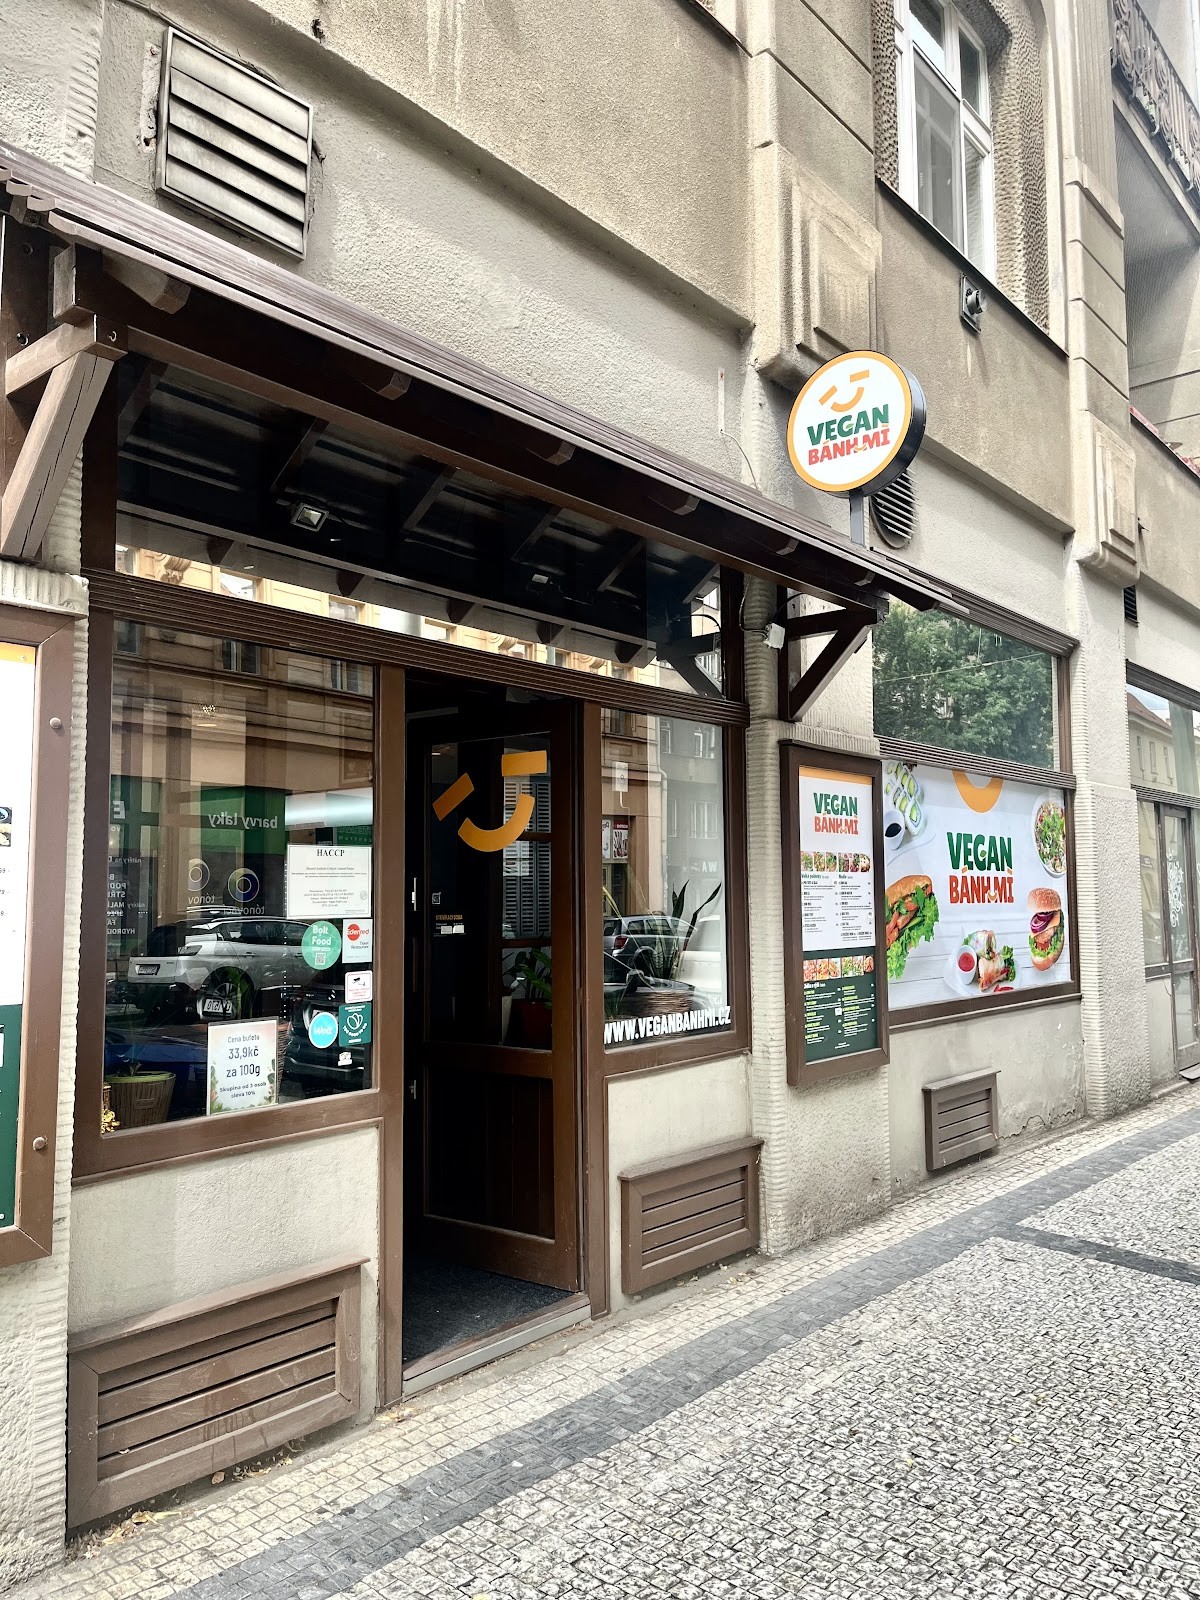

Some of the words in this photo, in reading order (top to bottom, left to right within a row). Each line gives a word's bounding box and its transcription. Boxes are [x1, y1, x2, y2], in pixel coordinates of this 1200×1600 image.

[807, 404, 889, 446] VEGAN
[808, 440, 858, 466] BÁNH
[813, 792, 858, 817] VEGAN
[814, 812, 843, 834] BÁNH
[316, 849, 345, 857] HACCP
[946, 832, 1013, 872] VEGAN
[949, 866, 991, 904] BÁNH
[311, 936, 332, 946] Food
[312, 925, 329, 935] Bolt
[604, 1005, 731, 1044] WWW.VEGANBANHMI.CZ
[227, 1036, 241, 1044] Cena
[228, 1045, 259, 1060] 33,9kč
[226, 1068, 237, 1078] za
[240, 1063, 260, 1077] 100g
